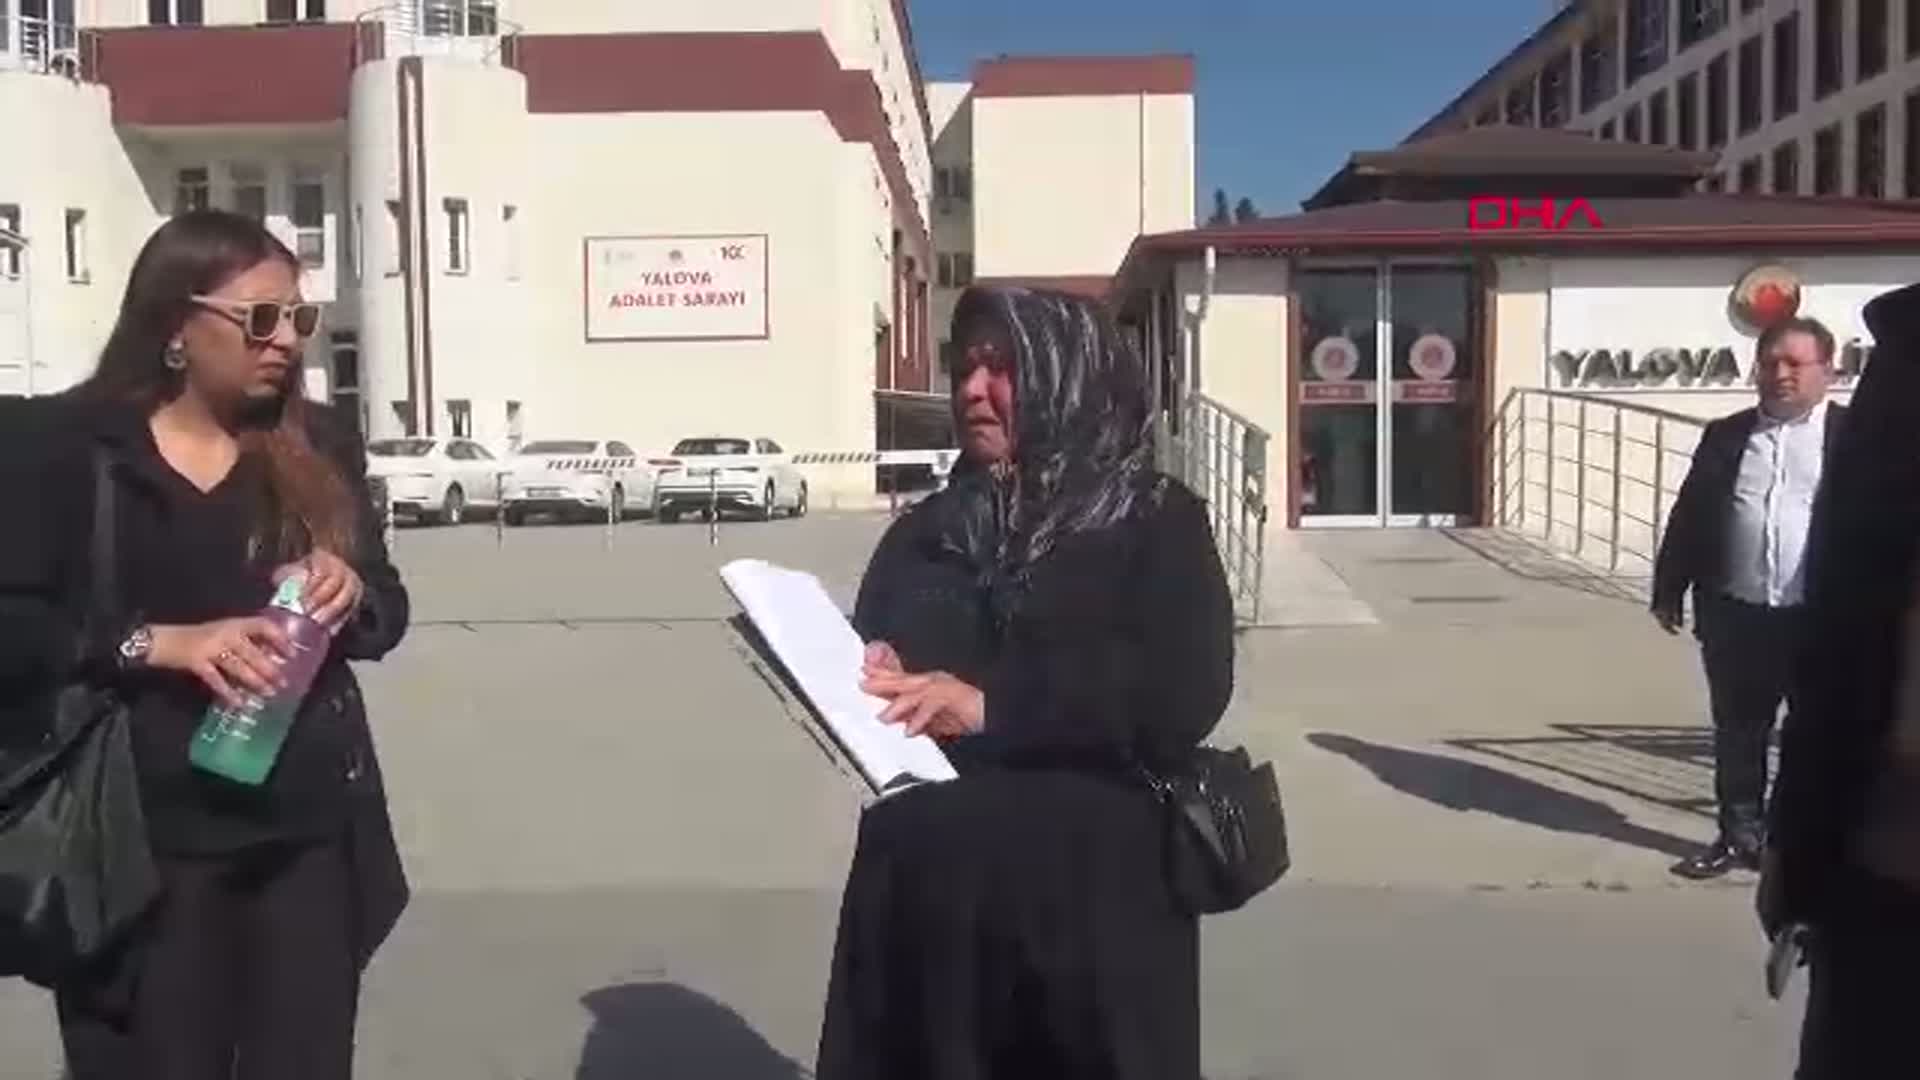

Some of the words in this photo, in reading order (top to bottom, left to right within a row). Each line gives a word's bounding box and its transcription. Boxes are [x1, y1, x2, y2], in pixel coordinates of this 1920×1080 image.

[641, 271, 713, 286] YALOVA
[609, 292, 676, 308] ADALET
[682, 290, 746, 307] SARAYI
[1551, 347, 1741, 387] YALOVA
